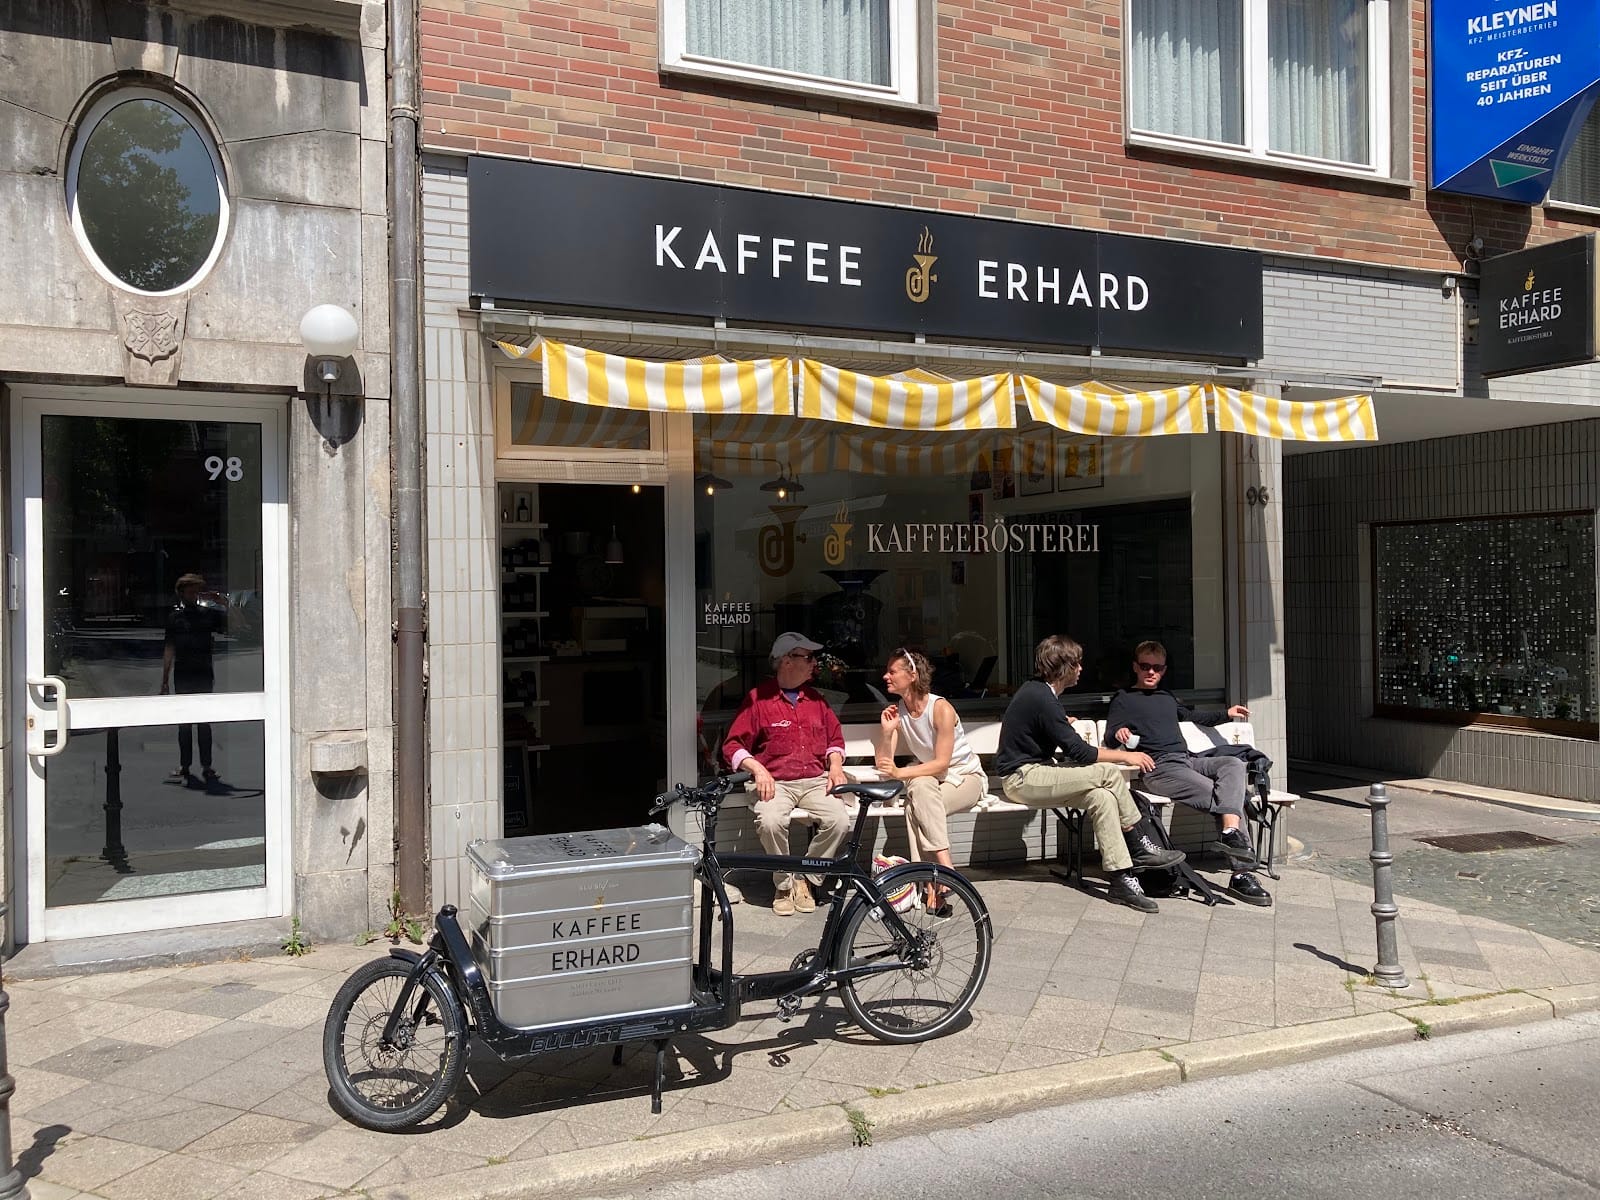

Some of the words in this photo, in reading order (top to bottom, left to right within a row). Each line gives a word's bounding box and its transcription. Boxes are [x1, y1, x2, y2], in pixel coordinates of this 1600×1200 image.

[1468, 0, 1557, 35] KLEYNEN
[1468, 36, 1483, 45] KFZ
[1487, 20, 1558, 41] MEISTERBETRIEB
[1466, 53, 1561, 82] REPARATUREN
[1497, 48, 1529, 62] KFZ-
[1480, 78, 1508, 93] SEIT
[1511, 71, 1548, 87] ÜBER
[1476, 95, 1494, 107] 40
[1497, 83, 1552, 104] JAHREN
[1507, 151, 1550, 165] WERKSTATT
[1516, 143, 1555, 156] EINFAHRT
[655, 224, 862, 287] KAFFEE
[978, 259, 1150, 312] ERHARD
[1500, 287, 1562, 312] KAFFEE
[1499, 304, 1562, 329] ERHARD
[204, 455, 244, 482] 98
[1246, 486, 1269, 506] 96
[866, 517, 1101, 553] KAFFEERÖSTEREI
[704, 602, 751, 613] KAFFEE
[705, 613, 751, 625] ERHARD
[801, 859, 833, 867] BULLITT
[552, 913, 641, 939] KAFFEE
[551, 943, 640, 971] ERHARD
[529, 1024, 621, 1053] BULLITT
